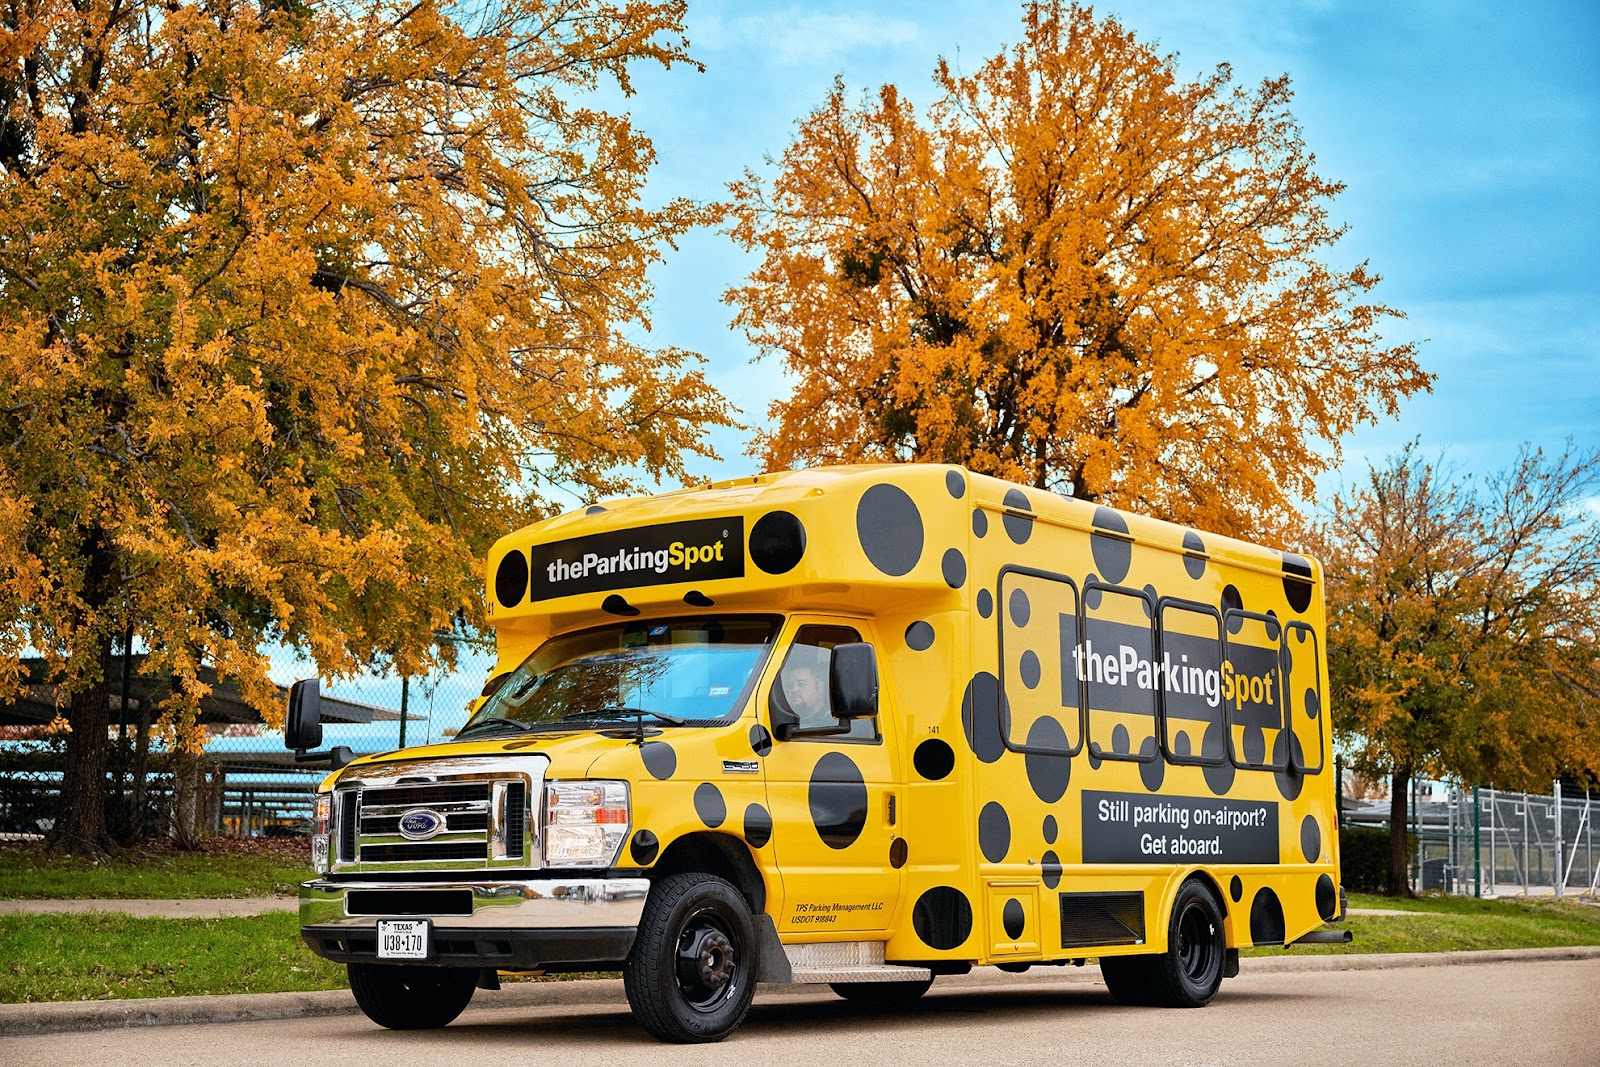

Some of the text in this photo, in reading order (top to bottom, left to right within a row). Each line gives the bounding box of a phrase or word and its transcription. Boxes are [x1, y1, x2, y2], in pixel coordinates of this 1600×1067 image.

[547, 540, 724, 583] theParkingSpot
[1072, 640, 1274, 711] theParkingSpot
[928, 726, 939, 734] 141
[1098, 799, 1267, 830] Still parking on-airport?
[1140, 833, 1223, 856] Get aboard.
[796, 902, 884, 913] TPS Parking Management LLC
[393, 923, 413, 931] TEXAS
[791, 915, 815, 924] USDOT
